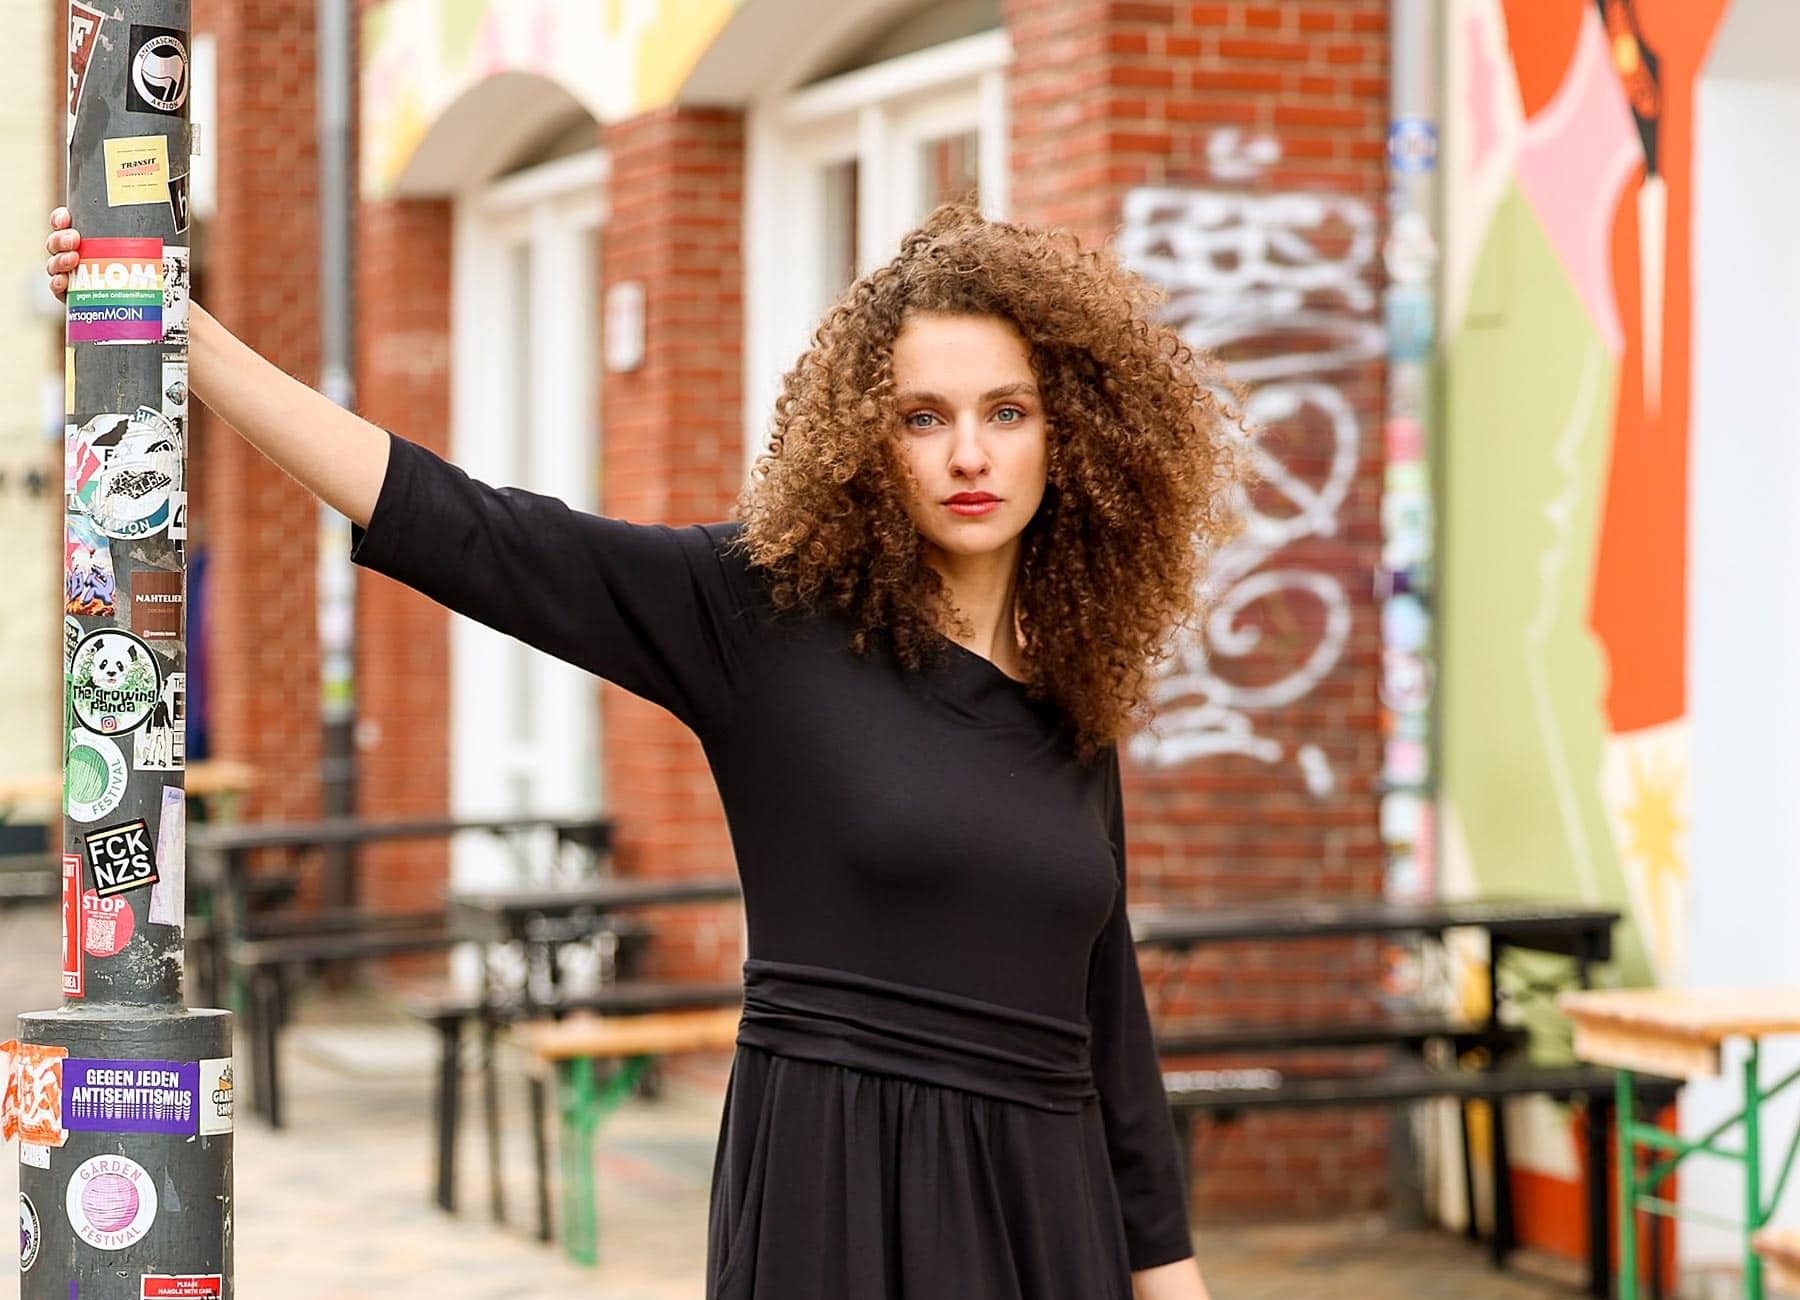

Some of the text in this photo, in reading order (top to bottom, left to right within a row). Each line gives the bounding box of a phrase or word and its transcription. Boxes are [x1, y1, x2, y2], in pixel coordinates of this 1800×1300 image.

[151, 98, 179, 110] AKTION
[120, 157, 157, 170] TRANSIT
[73, 686, 157, 705] The growing
[90, 700, 136, 715] panda
[91, 757, 124, 816] FESTIVAL
[88, 829, 149, 866] FCK
[94, 855, 151, 888] NZS
[82, 895, 126, 912] STOP
[86, 1069, 180, 1088] GEGEN JEDEN
[71, 1087, 192, 1114] ANTISEMITISMUS
[80, 1226, 142, 1246] FESTIVAL
